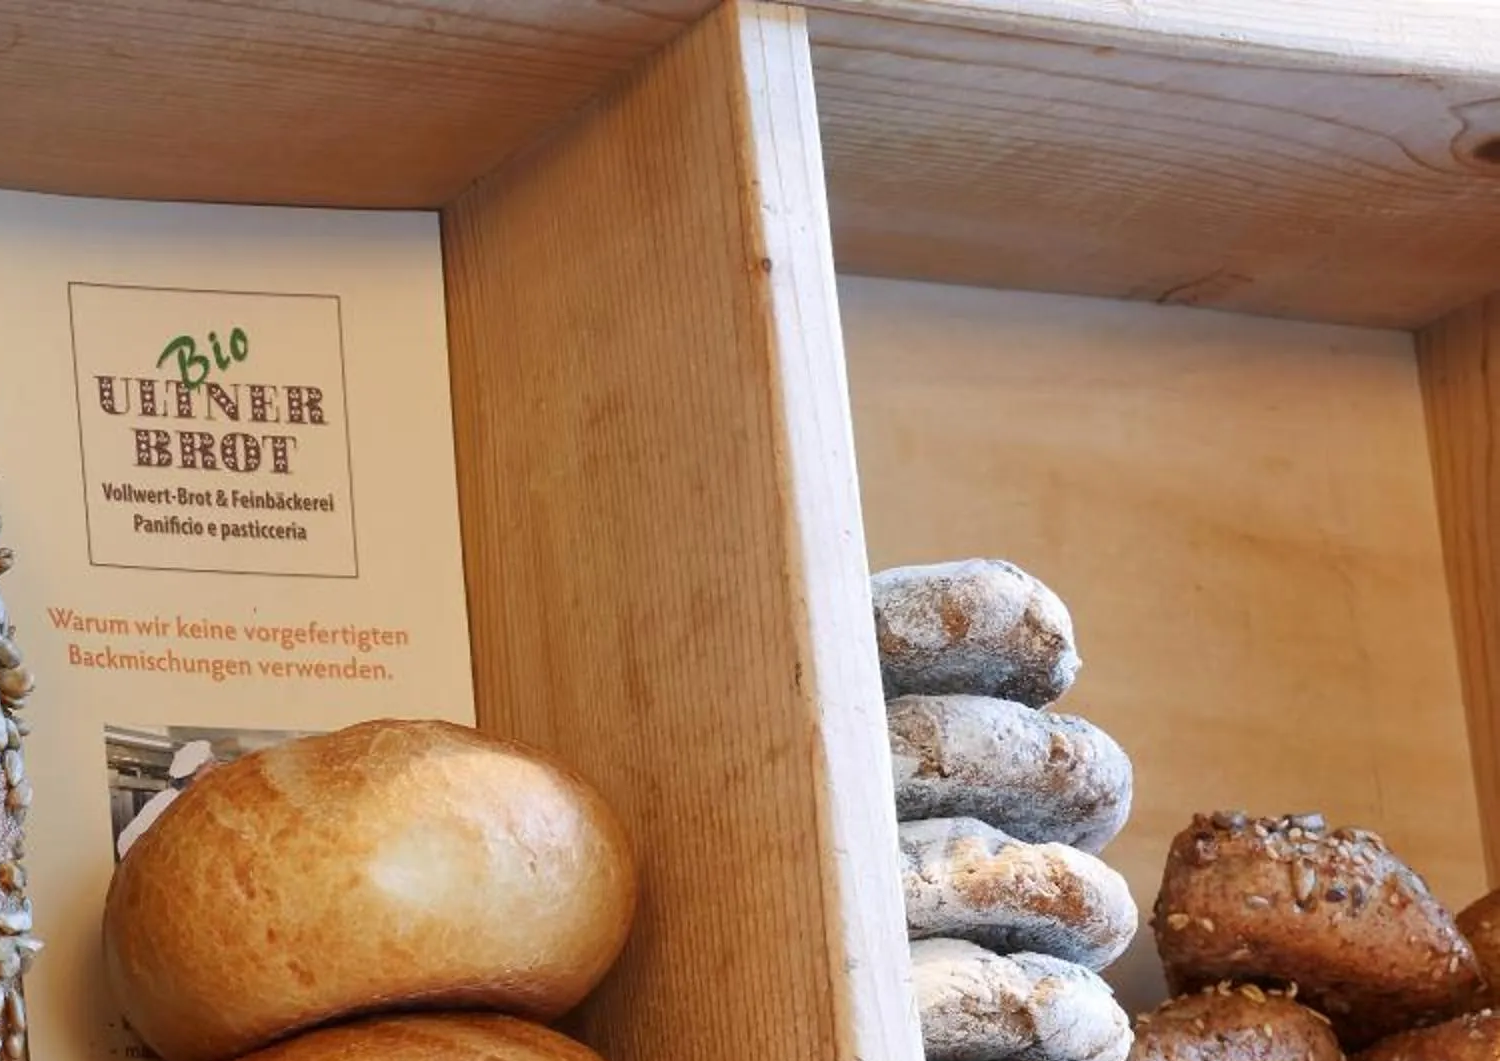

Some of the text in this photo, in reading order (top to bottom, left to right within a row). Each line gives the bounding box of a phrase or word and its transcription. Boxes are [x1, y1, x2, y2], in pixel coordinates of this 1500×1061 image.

[156, 327, 249, 389] Bio
[94, 375, 329, 425] ULTNER
[132, 428, 297, 474] BROT
[102, 482, 335, 512] Vollwert-Brot & Feinbäckerei
[133, 513, 308, 541] Panificio e pasticceria
[47, 607, 409, 652] Warum wir keine vorgefertigten
[68, 643, 394, 682] Backmischungen verwenden.
